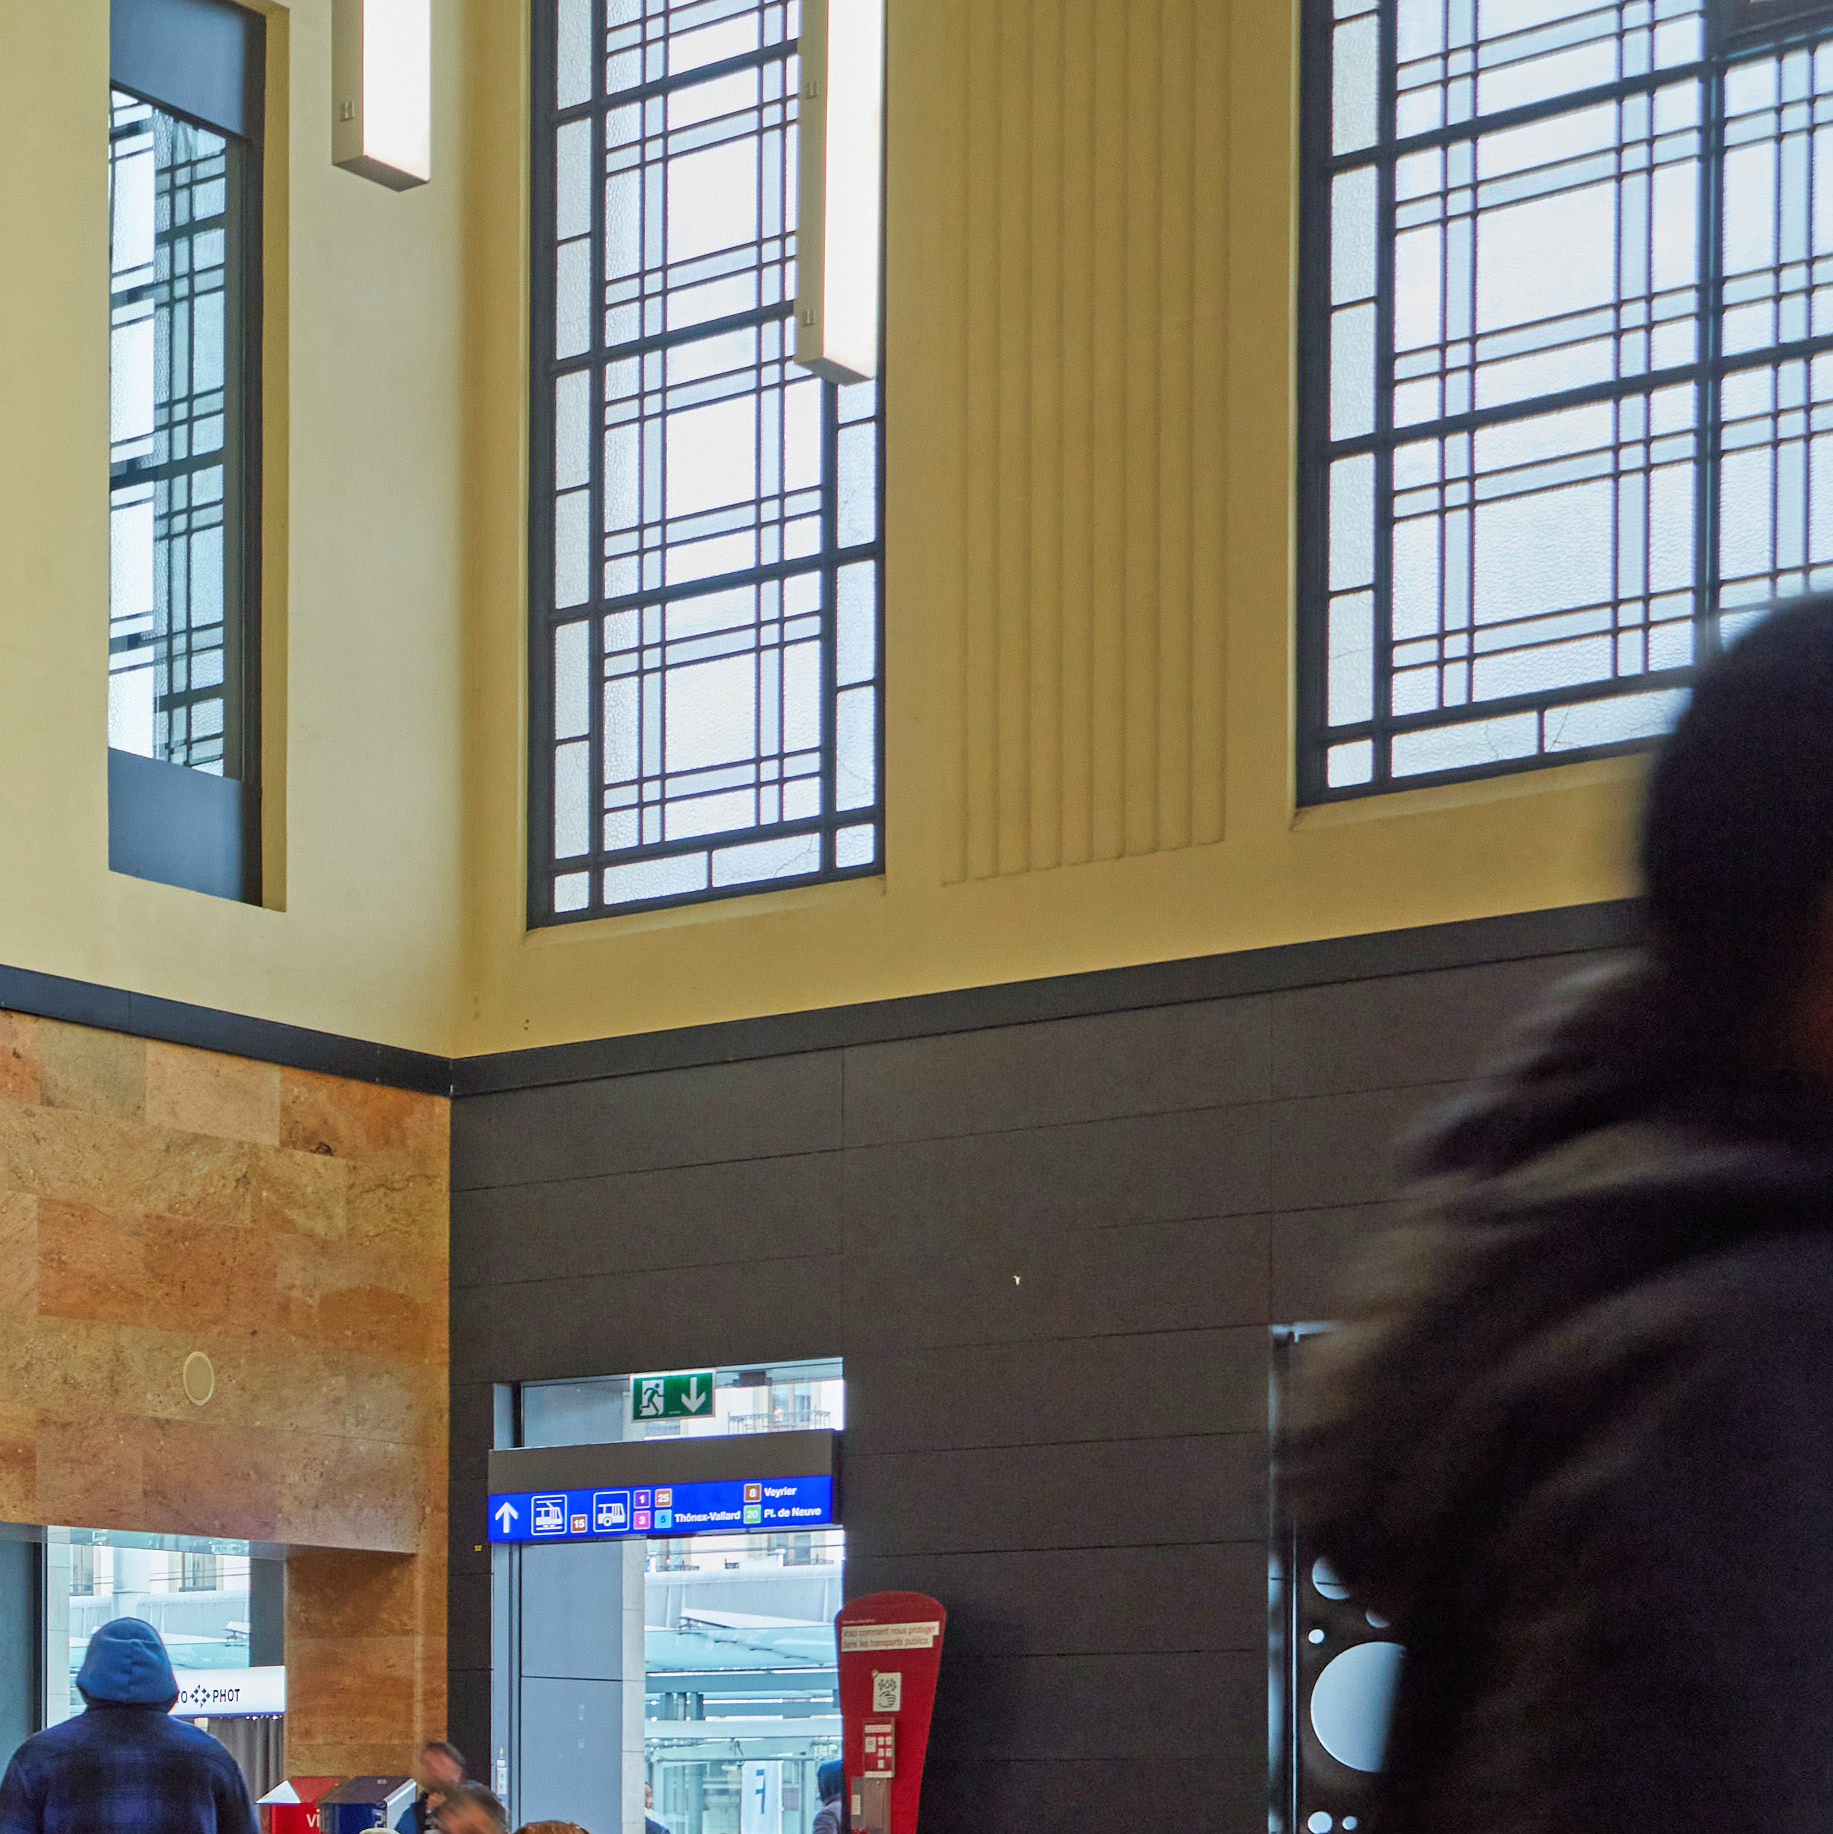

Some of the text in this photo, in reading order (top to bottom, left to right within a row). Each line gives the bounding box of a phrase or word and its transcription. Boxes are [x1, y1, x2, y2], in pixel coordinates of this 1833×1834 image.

[657, 1493, 670, 1503] 25
[763, 1485, 798, 1498] Veyrier
[673, 1509, 741, 1523] Thônex-Vallard
[746, 1509, 759, 1519] 20
[777, 1508, 790, 1518] de
[792, 1506, 822, 1518] Neuve
[573, 1518, 585, 1529] 15
[212, 1688, 241, 1703] PHOT
